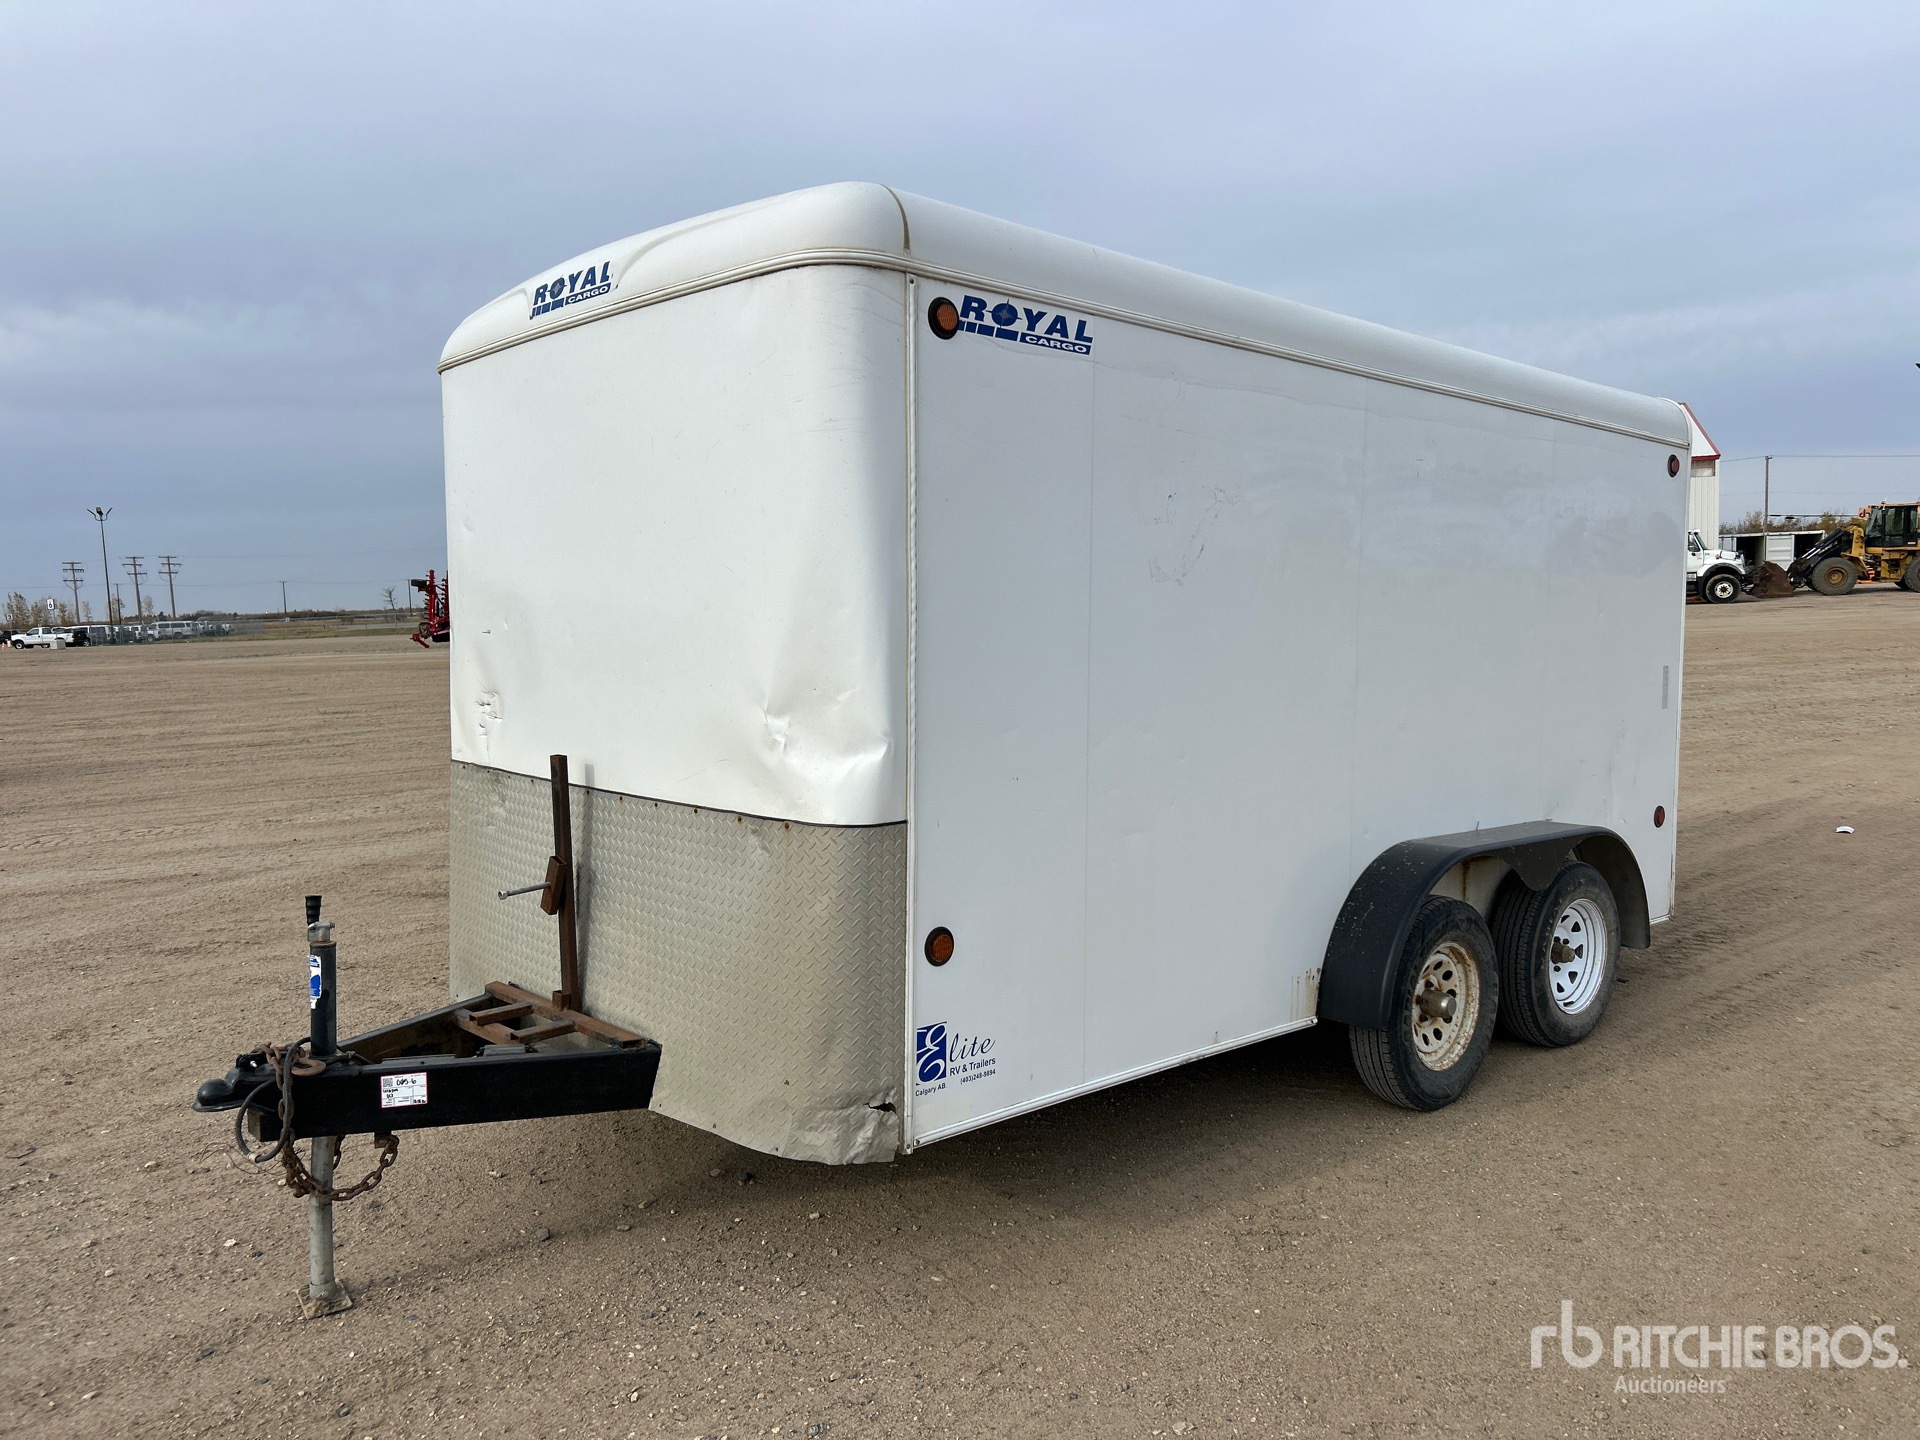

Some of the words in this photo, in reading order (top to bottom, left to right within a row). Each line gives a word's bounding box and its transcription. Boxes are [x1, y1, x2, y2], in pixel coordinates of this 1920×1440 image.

[533, 261, 610, 306] ROYAL
[568, 285, 608, 304] CARGO
[960, 295, 1093, 343] ROYAL
[1025, 335, 1087, 353] CARGO
[950, 1066, 960, 1076] RV
[962, 1064, 967, 1073] &
[969, 1057, 996, 1070] Trailers
[915, 1087, 936, 1096] Calgary
